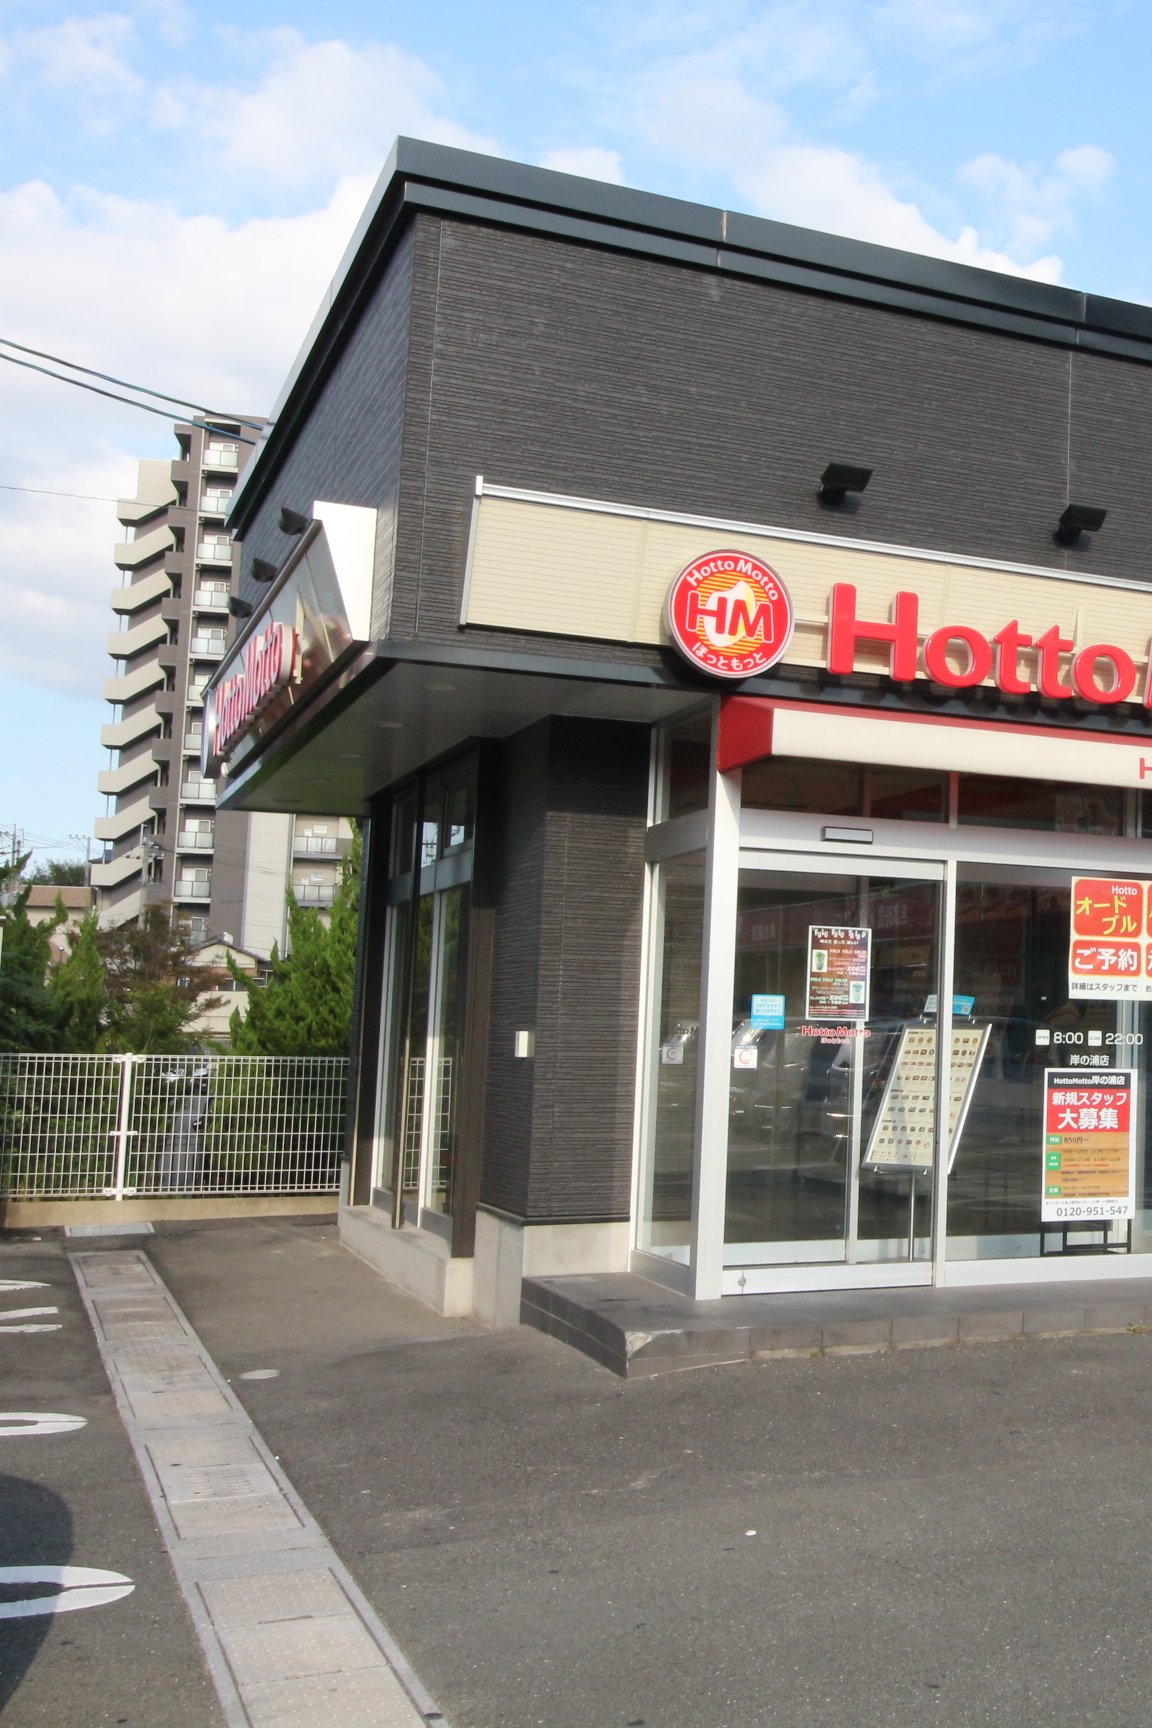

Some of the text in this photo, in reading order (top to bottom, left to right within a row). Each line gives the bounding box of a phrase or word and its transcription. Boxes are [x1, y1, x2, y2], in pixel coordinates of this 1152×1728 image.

[686, 590, 774, 643] HM
[692, 642, 767, 671] ほっともっと
[1111, 885, 1138, 896] Hotto
[1076, 895, 1127, 915] オード
[1102, 915, 1137, 935] ブル
[1074, 947, 1138, 971] ご予約
[1053, 1031, 1084, 1044] 8:00
[1105, 1033, 1144, 1045] 22:00
[1069, 1054, 1110, 1067] 岸の浦店
[1052, 1091, 1127, 1106] 新規スタッフ
[1058, 1107, 1119, 1130] 大募集
[1056, 1205, 1129, 1218] 0120-951-547
